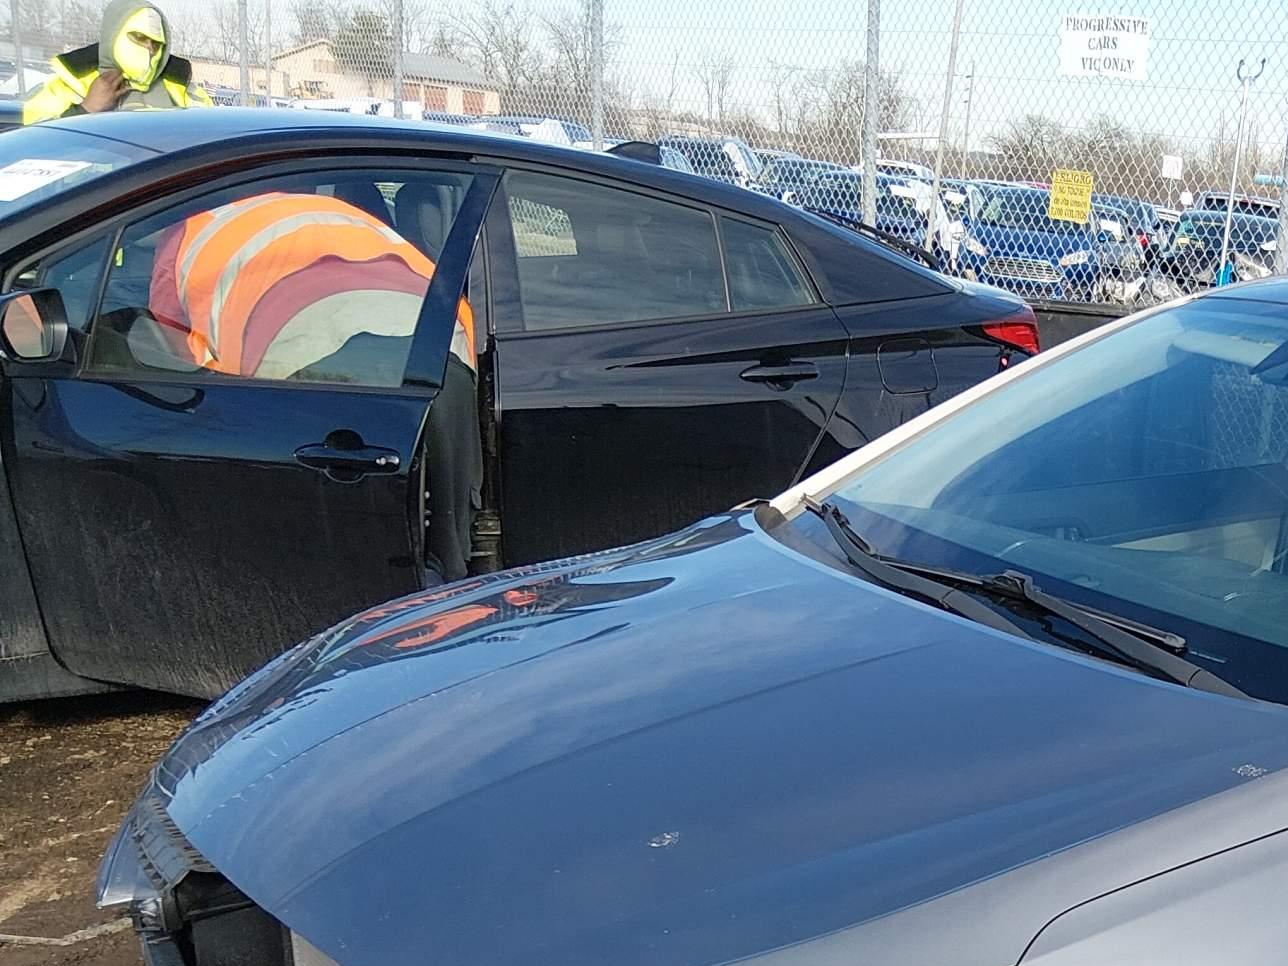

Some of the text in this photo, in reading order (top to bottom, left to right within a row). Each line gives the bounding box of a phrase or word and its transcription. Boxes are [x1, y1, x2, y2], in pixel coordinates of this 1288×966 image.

[1065, 16, 1148, 35] PROGRESSIVE
[1087, 36, 1118, 51] CARS
[1103, 56, 1135, 73] ONLY
